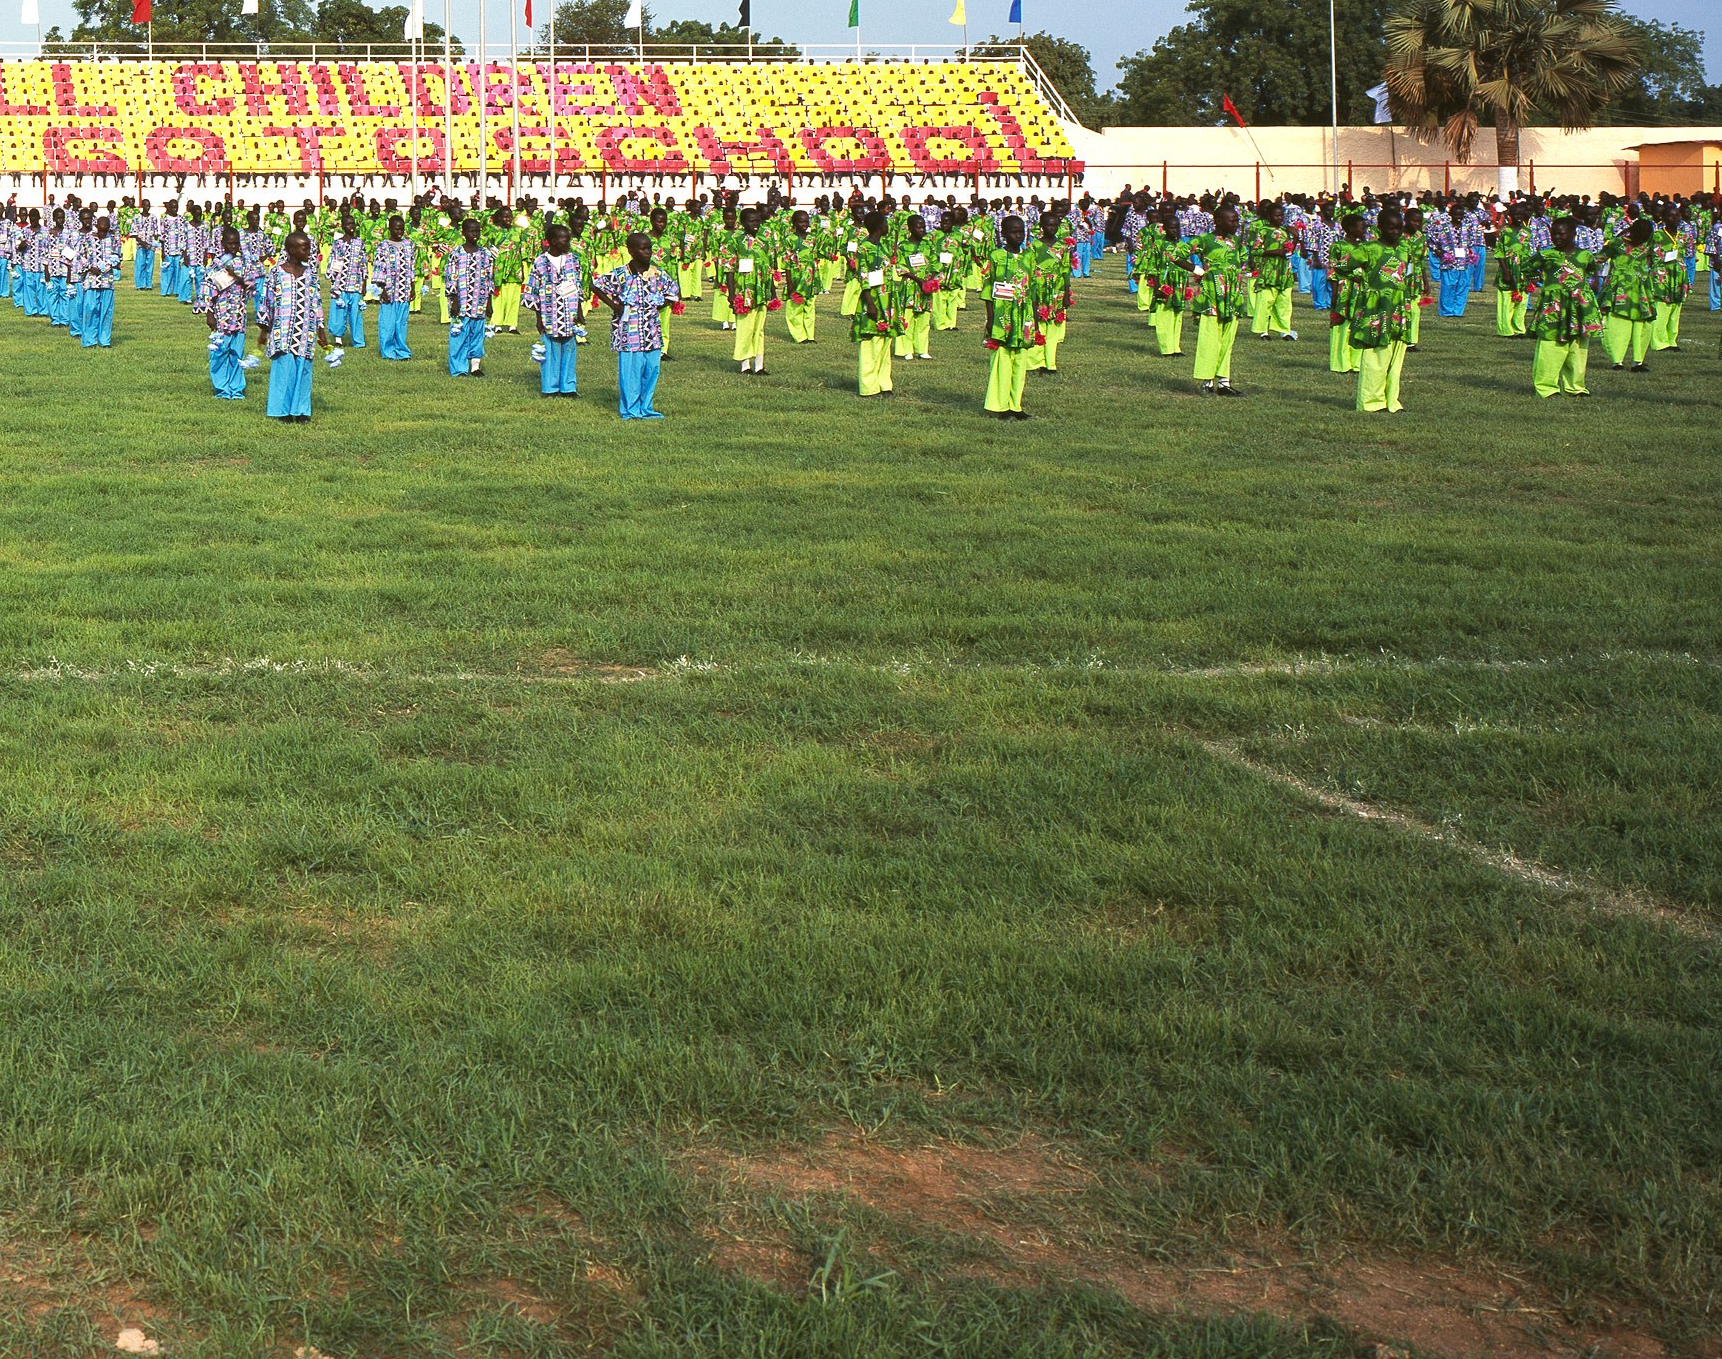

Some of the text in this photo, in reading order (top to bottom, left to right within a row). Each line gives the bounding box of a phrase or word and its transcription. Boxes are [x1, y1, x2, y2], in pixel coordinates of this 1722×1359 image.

[171, 63, 682, 117] CHILDREN
[43, 92, 1085, 173] GO TO SCHOOL
